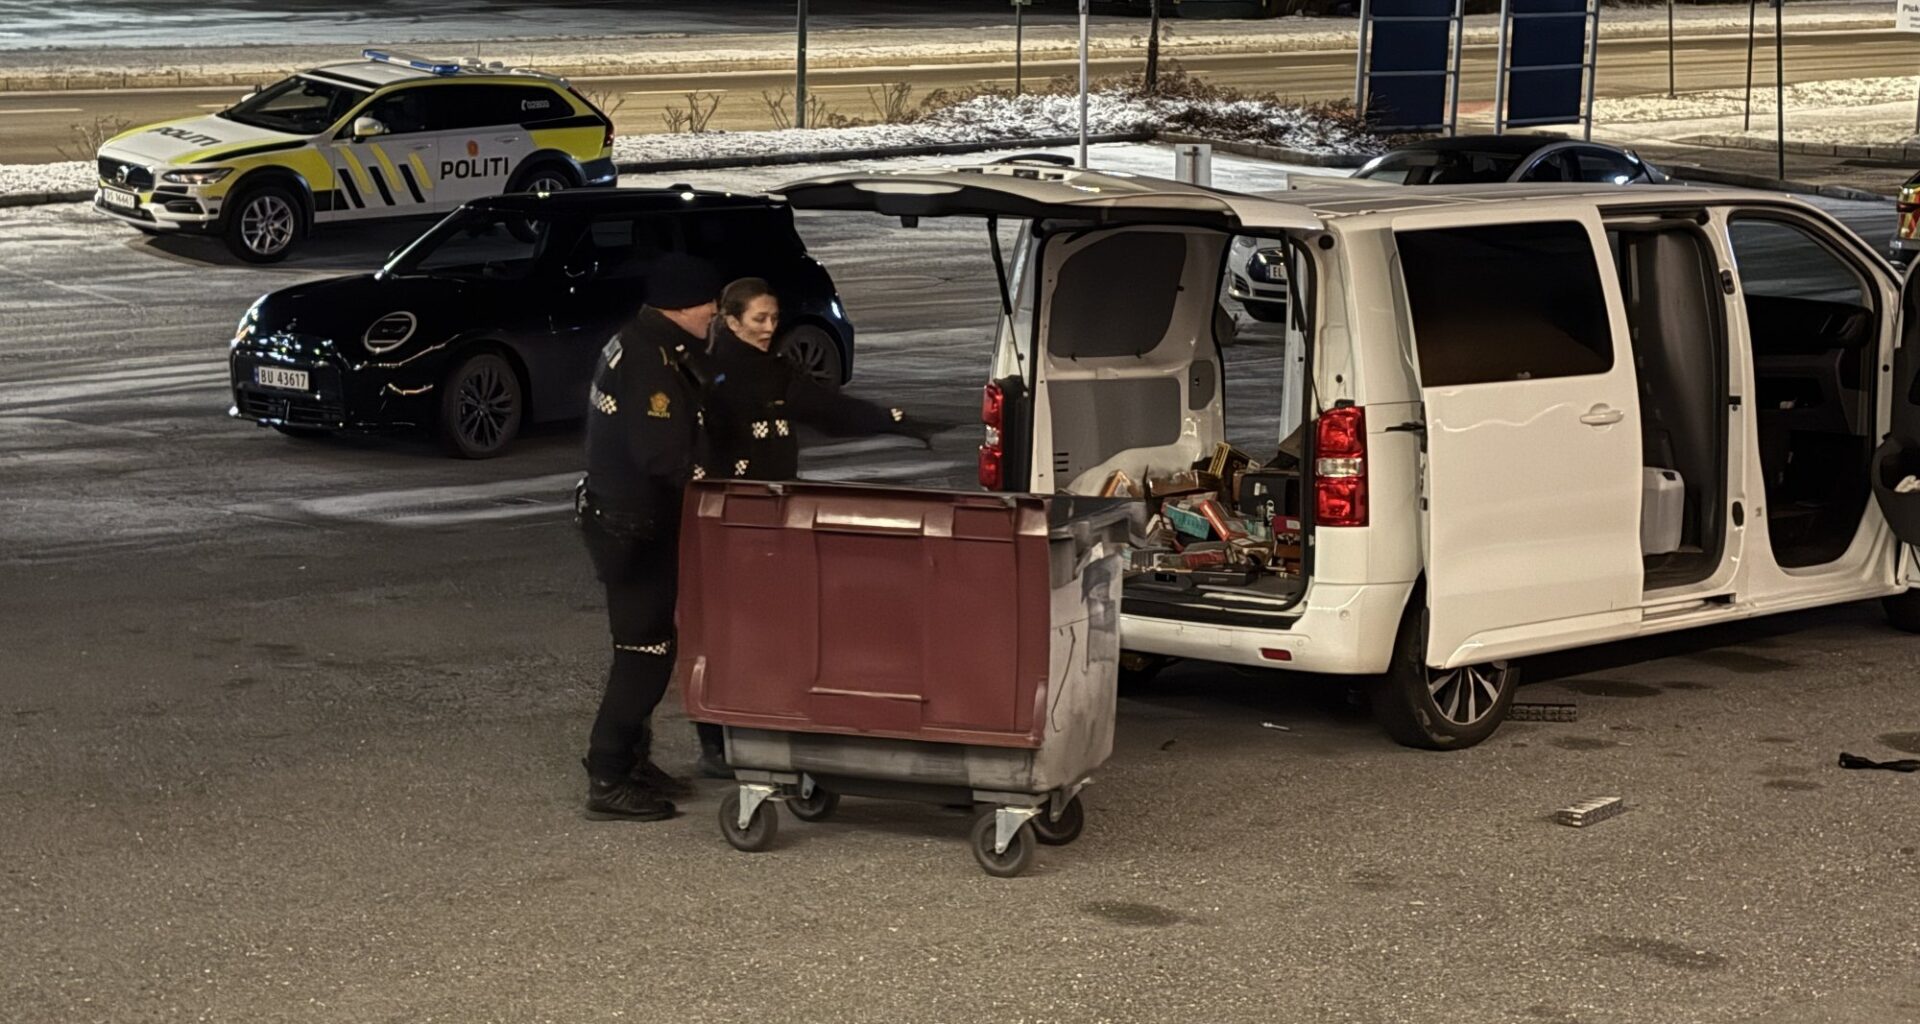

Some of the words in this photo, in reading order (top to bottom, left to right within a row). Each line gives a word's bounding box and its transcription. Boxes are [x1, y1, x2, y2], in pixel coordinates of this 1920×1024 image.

[147, 127, 223, 146] POLITI
[441, 157, 509, 180] POLITI
[261, 369, 274, 384] BU
[277, 371, 306, 388] 43617
